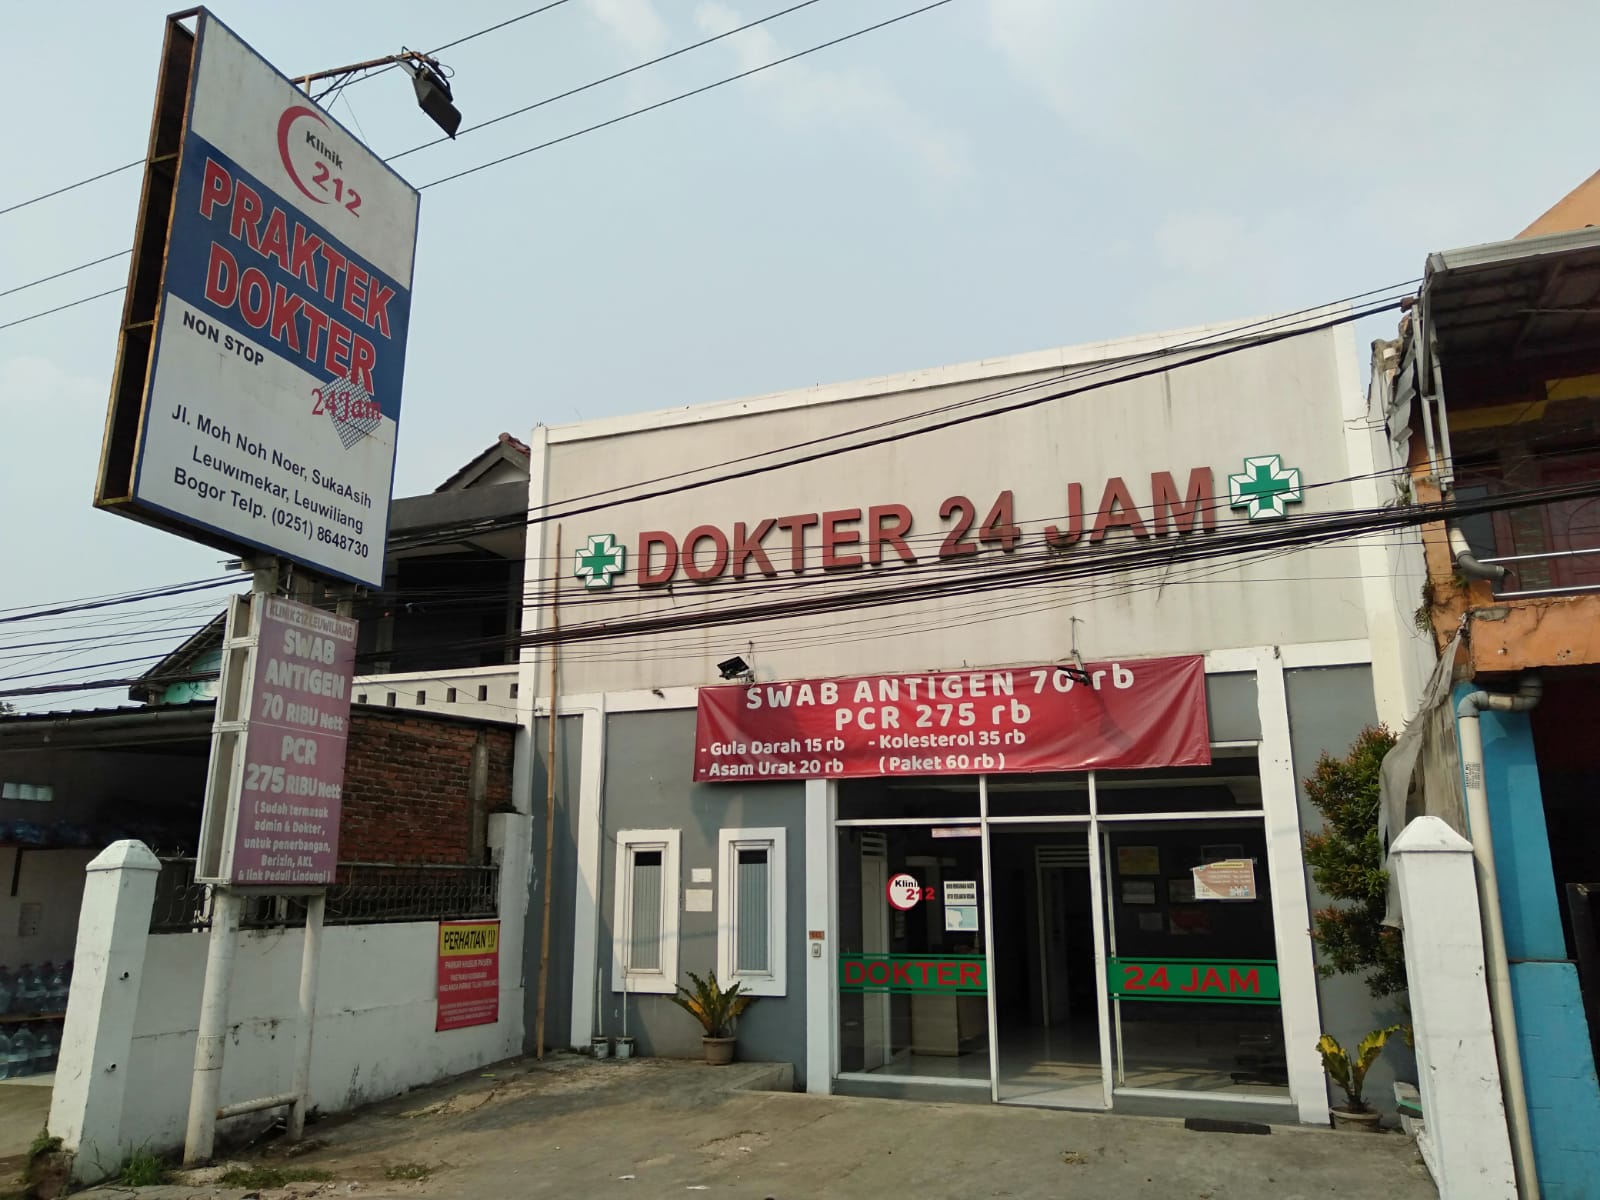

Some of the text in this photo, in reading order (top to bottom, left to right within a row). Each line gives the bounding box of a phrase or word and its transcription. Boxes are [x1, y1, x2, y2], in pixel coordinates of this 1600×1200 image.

[306, 131, 343, 170] Klinik
[311, 161, 362, 218] 212
[200, 157, 396, 339] PRAKTEK
[204, 241, 376, 396] DOKTER
[183, 311, 264, 366] NON STOP
[172, 404, 372, 509] Jl. Moh Noh Noer, SukaAsih
[174, 466, 369, 558] Bogor Telp. (0251) 8648730
[294, 489, 363, 535] Leuwiliang
[637, 466, 1216, 588] DOKTER 24 JAM
[283, 629, 335, 664] SWAB
[265, 658, 345, 699] ANTIGEN
[746, 682, 838, 709] SWAB
[853, 672, 1014, 703] ANTIGEN
[1092, 663, 1135, 690] rb
[261, 692, 283, 720] 70
[286, 703, 318, 726] RIBU
[835, 699, 1031, 731] PCR 275 rb
[281, 736, 317, 765] PCR
[710, 741, 746, 756] Gula
[751, 738, 801, 755] Darah
[804, 739, 822, 752] 15
[825, 737, 845, 752] rb
[879, 730, 974, 748] Kolesterol
[978, 731, 1000, 746] 35
[1004, 729, 1026, 745] rb
[709, 762, 754, 776] Asam
[758, 760, 796, 774] Urat
[799, 759, 821, 773] 20
[824, 758, 844, 773] rb
[889, 755, 941, 770] Paket
[946, 755, 970, 769] 60
[973, 753, 994, 768] rb
[245, 763, 286, 793] 275
[285, 775, 317, 796] RIBU
[906, 887, 935, 900] 212
[444, 930, 486, 950] PERHATIAN
[845, 961, 981, 985] DOKTER
[1123, 966, 1259, 993] 24 JAM
